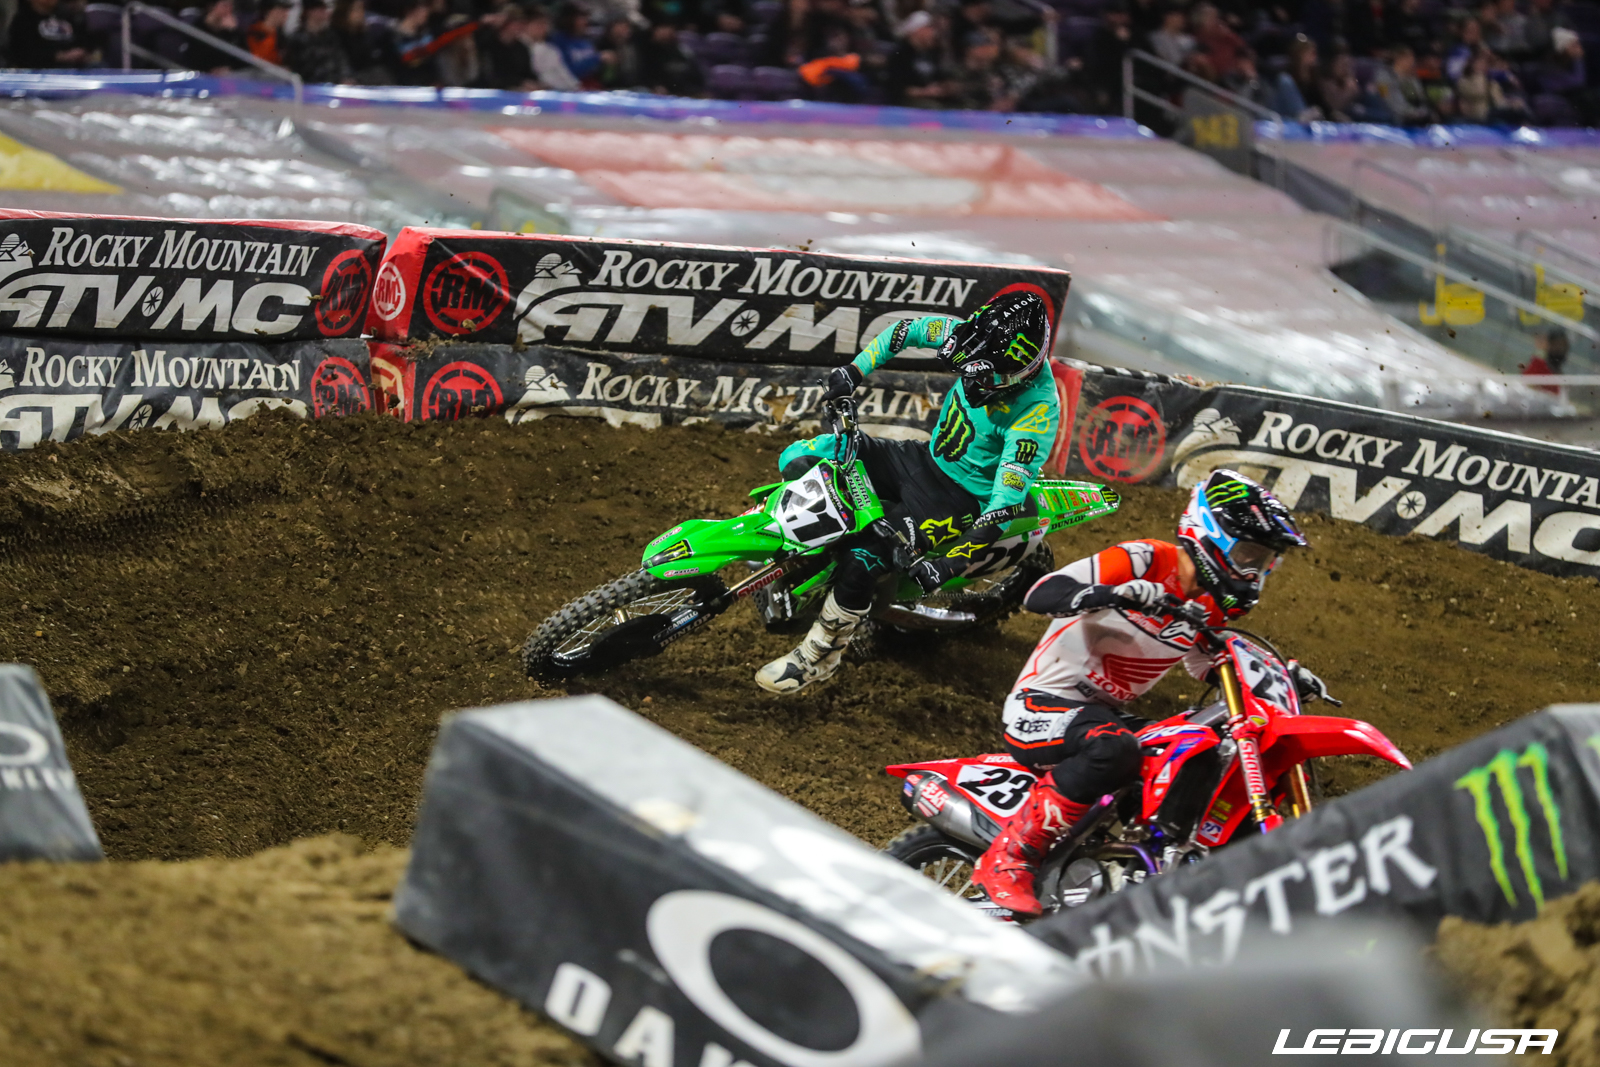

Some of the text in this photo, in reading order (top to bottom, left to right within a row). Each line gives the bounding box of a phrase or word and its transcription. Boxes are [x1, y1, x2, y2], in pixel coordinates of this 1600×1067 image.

[38, 227, 319, 276] ROCKY MOUNTAIN
[588, 250, 978, 307] ROCKY MOUNTAIN
[1003, 293, 1036, 318] AIROH
[19, 347, 300, 391] ROCKY MOUNTAIN
[576, 362, 701, 408] ROCKY
[1247, 411, 1402, 468] ROCKY
[1051, 515, 1087, 530] DUNLOP
[960, 541, 1028, 578] 21
[737, 567, 783, 598] SHOWA
[1084, 669, 1138, 701] HOND
[957, 768, 1036, 811] 23
[1241, 741, 1267, 796] SHOWA
